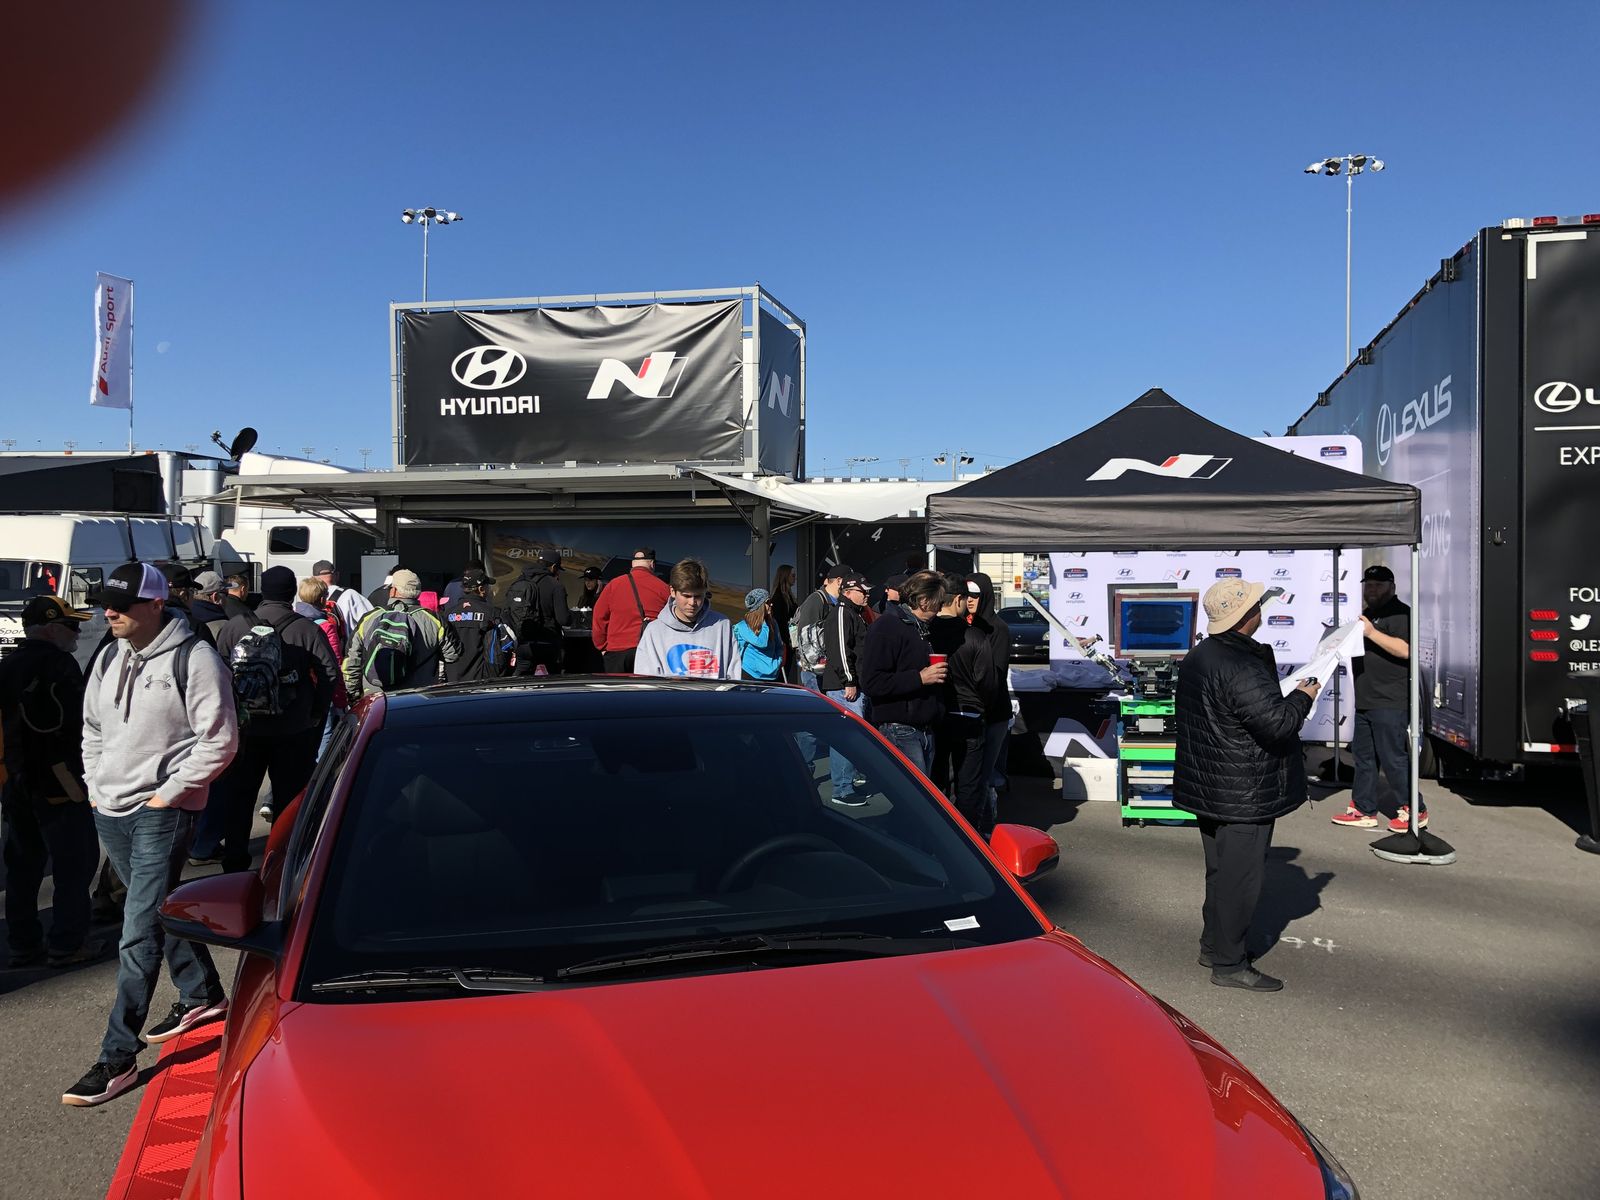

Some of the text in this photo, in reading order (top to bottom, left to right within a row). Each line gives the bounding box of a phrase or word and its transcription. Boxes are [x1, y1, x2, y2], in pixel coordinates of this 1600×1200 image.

[106, 286, 117, 333] Sport
[440, 396, 540, 416] HYUNDAI
[1392, 374, 1453, 446] LEXUS
[1559, 446, 1600, 466] EXP
[871, 527, 884, 542] 4
[1569, 587, 1600, 603] FOL
